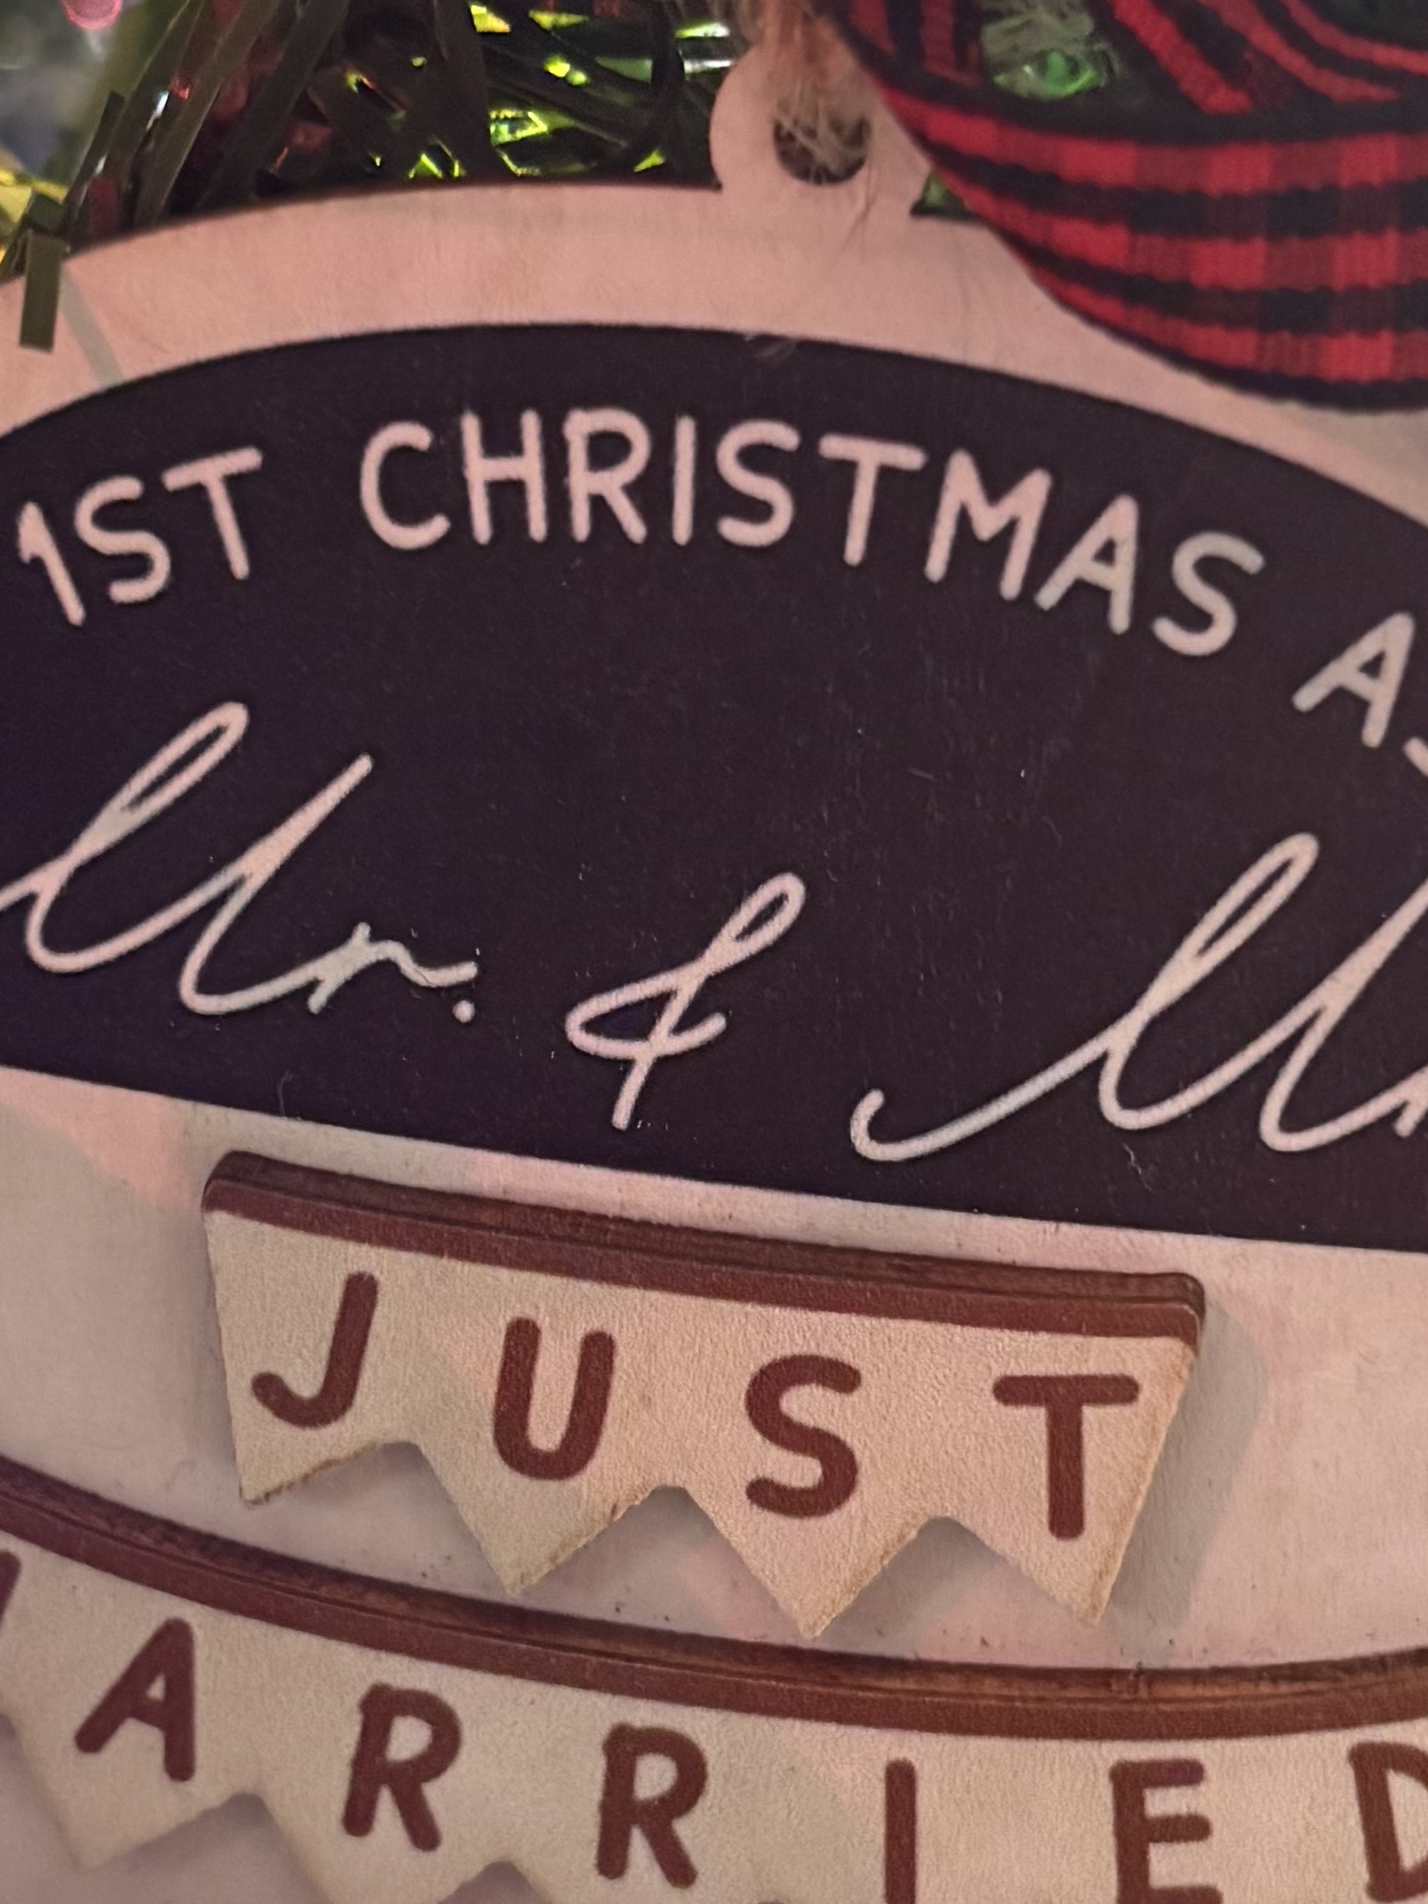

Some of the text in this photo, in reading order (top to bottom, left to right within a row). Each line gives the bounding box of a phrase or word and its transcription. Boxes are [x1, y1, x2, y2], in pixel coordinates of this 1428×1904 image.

[18, 447, 264, 625] 1ST
[359, 407, 1264, 656] CHRISTMAS
[565, 872, 805, 1129] &
[250, 1272, 1140, 1541] JUST
